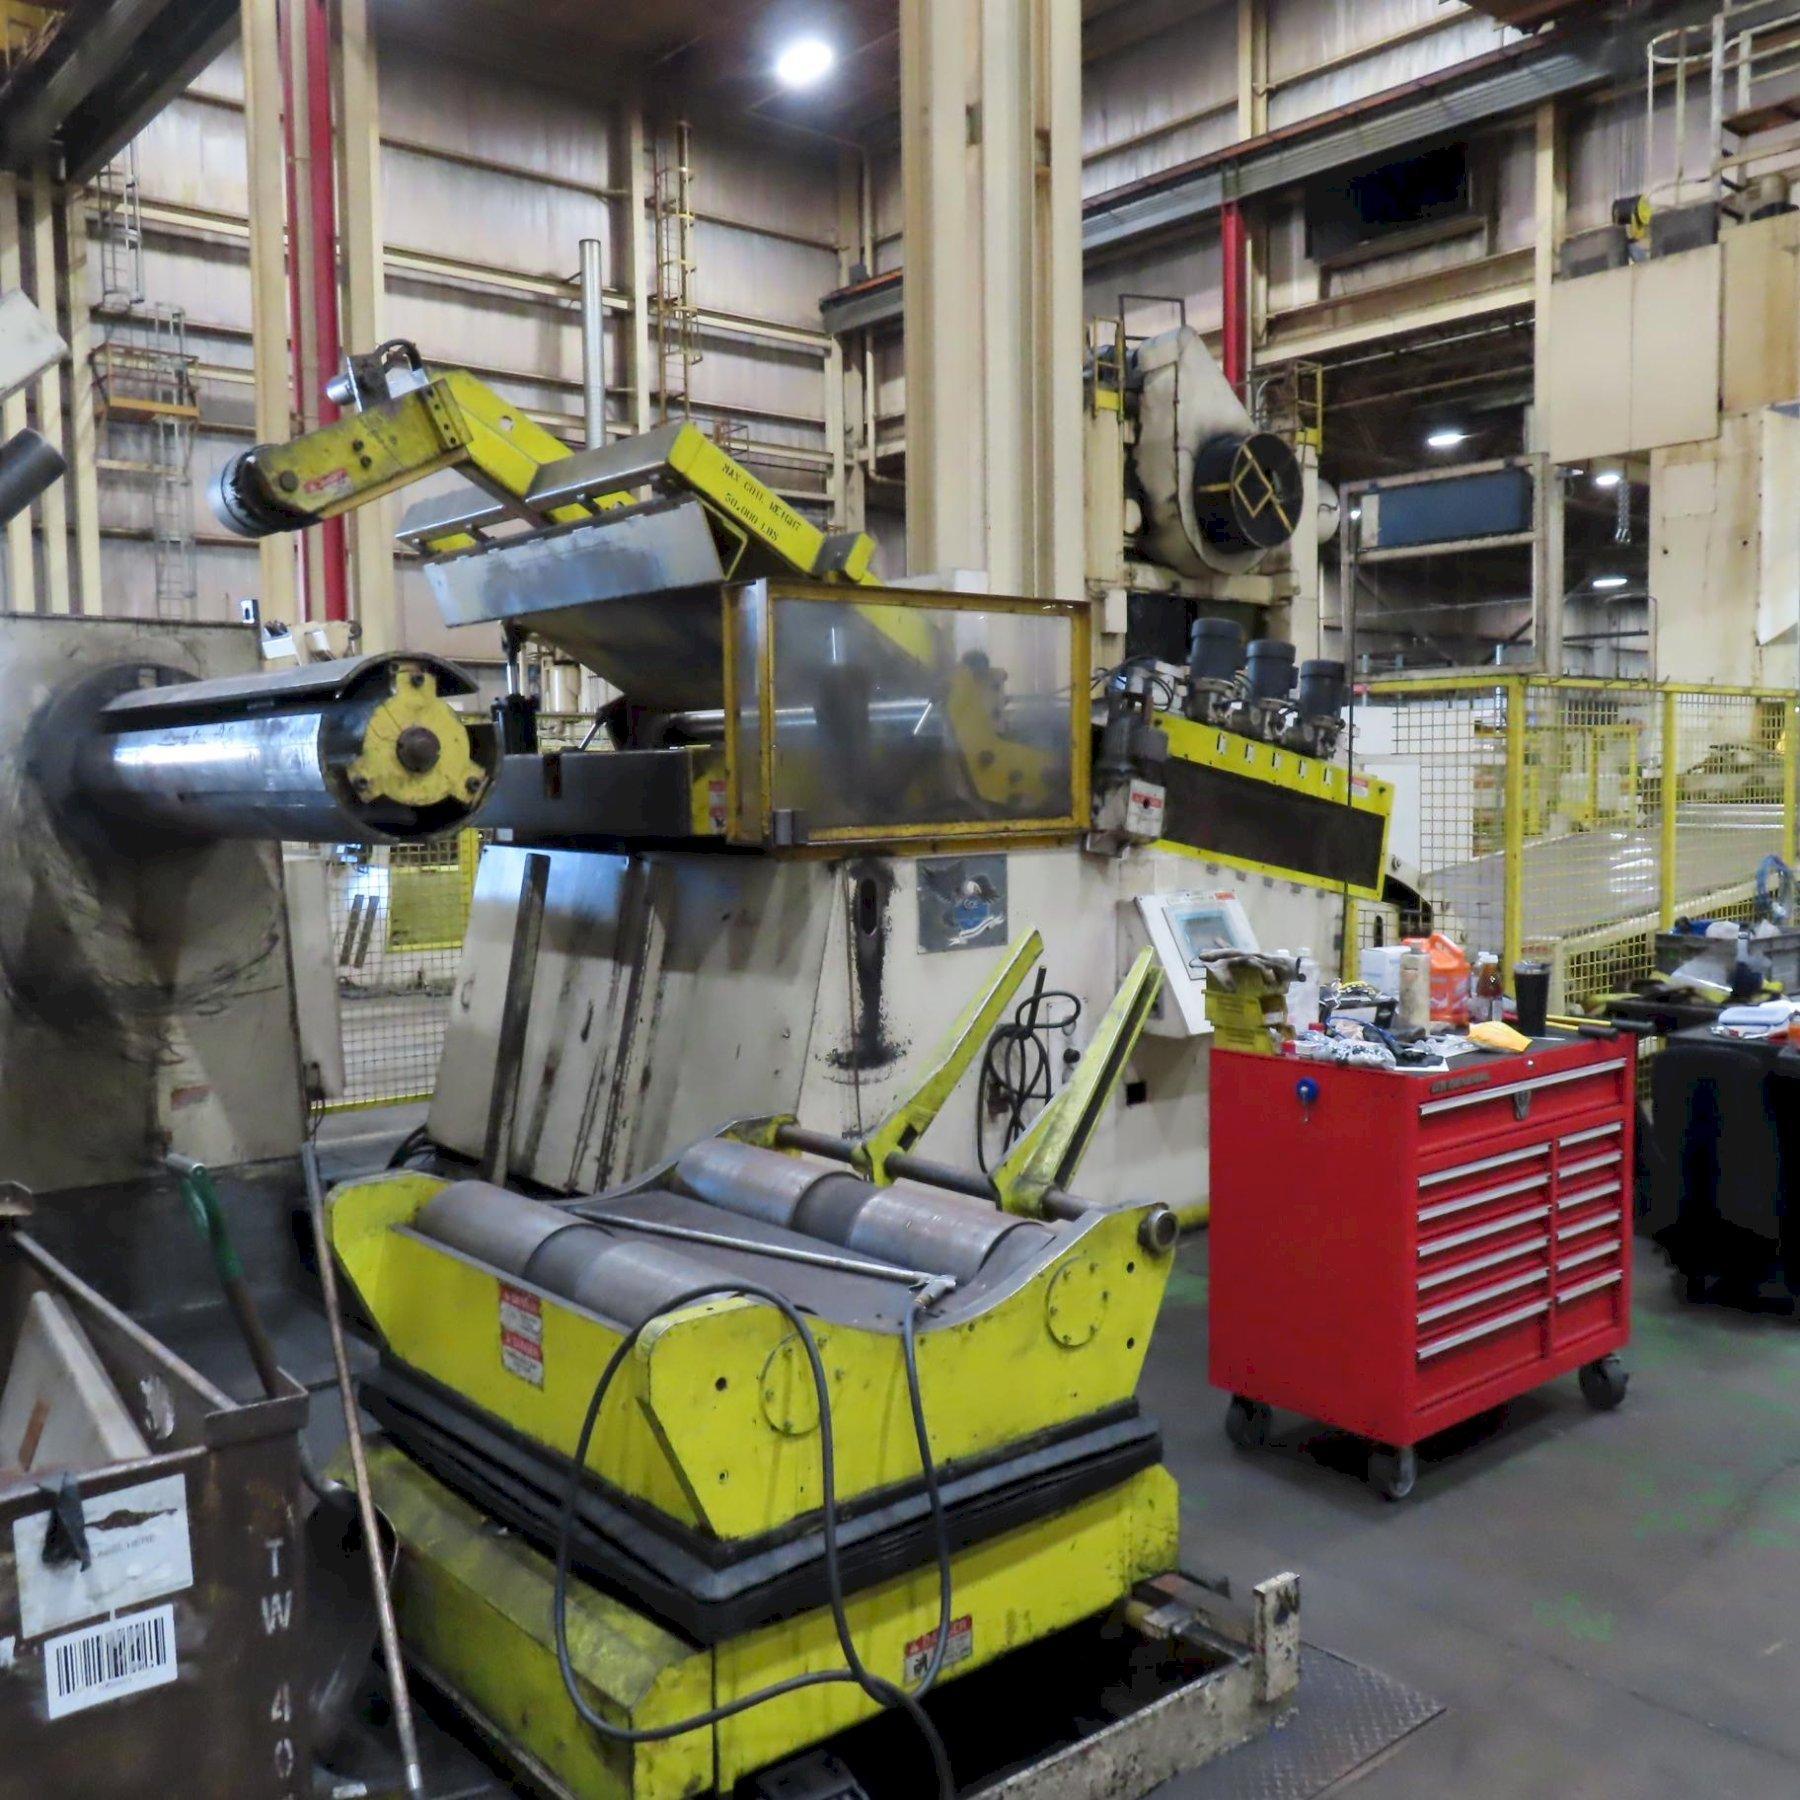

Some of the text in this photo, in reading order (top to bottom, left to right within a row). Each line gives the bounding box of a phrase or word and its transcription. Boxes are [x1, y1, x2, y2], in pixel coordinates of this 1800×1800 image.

[722, 463, 801, 532] MAX COIL WEIGHT
[760, 522, 779, 542] LBS
